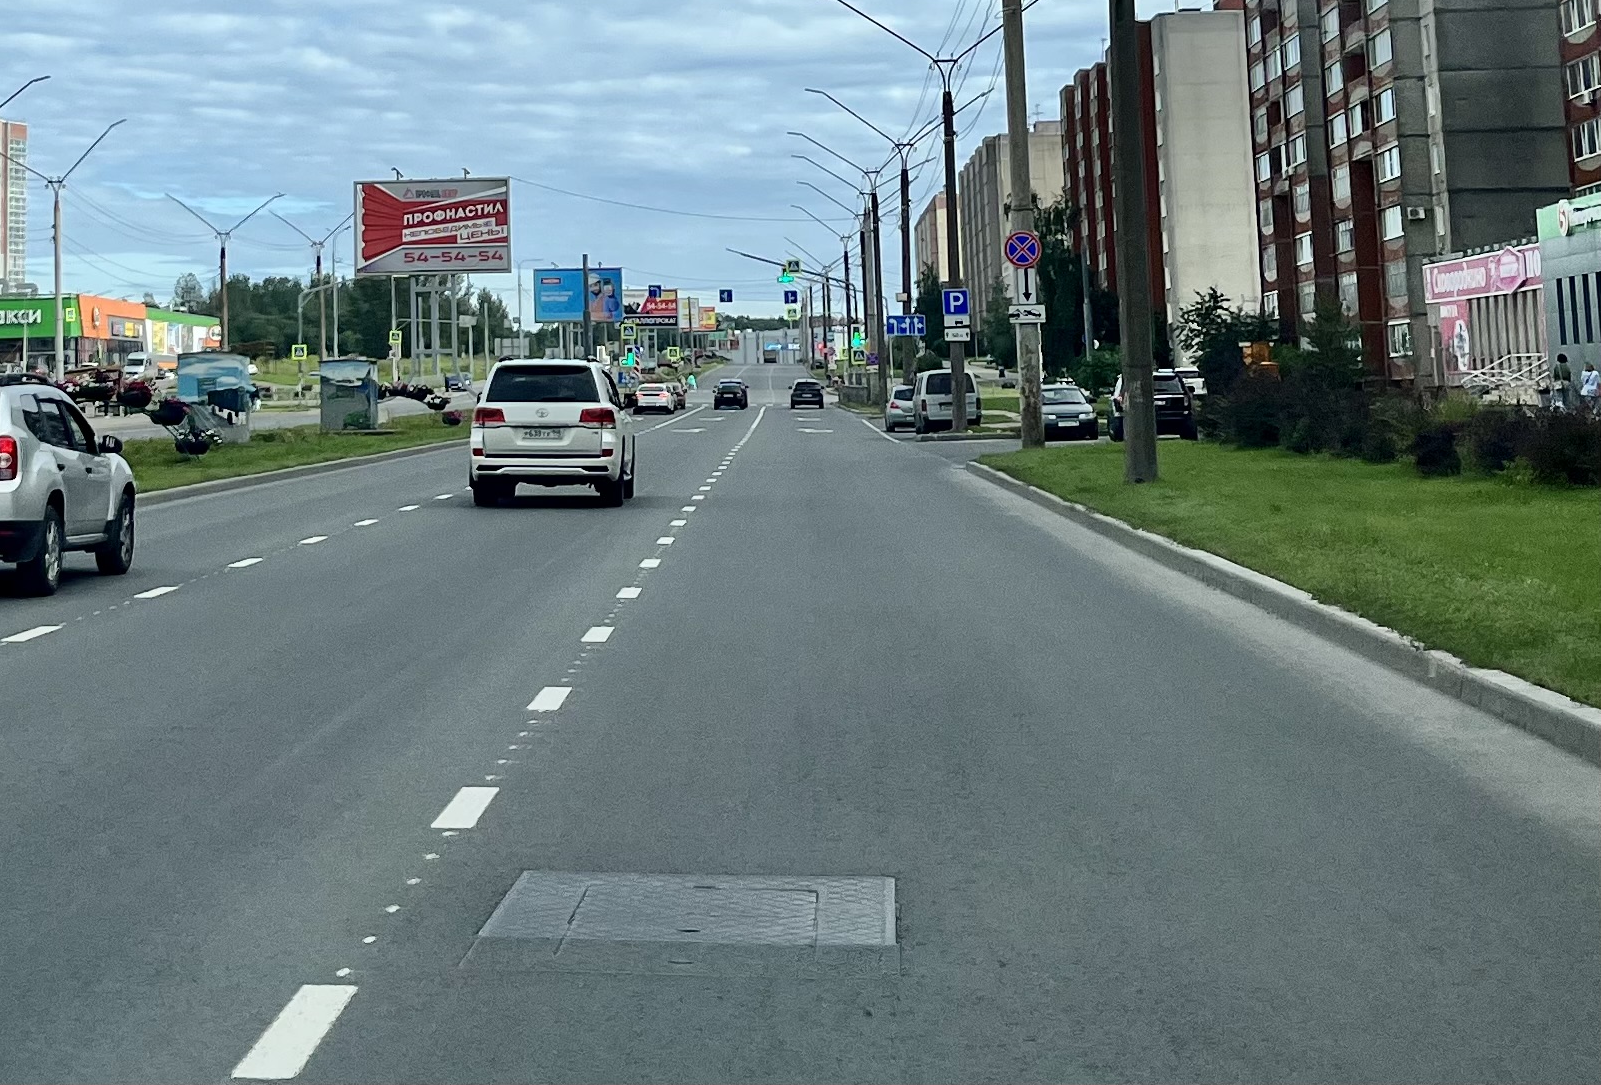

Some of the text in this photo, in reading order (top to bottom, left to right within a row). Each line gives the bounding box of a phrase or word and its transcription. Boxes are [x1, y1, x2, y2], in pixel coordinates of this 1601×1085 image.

[403, 202, 504, 226] ПРОФНАСТИЛ
[404, 250, 504, 264] 54-54-54
[949, 292, 964, 313] P
